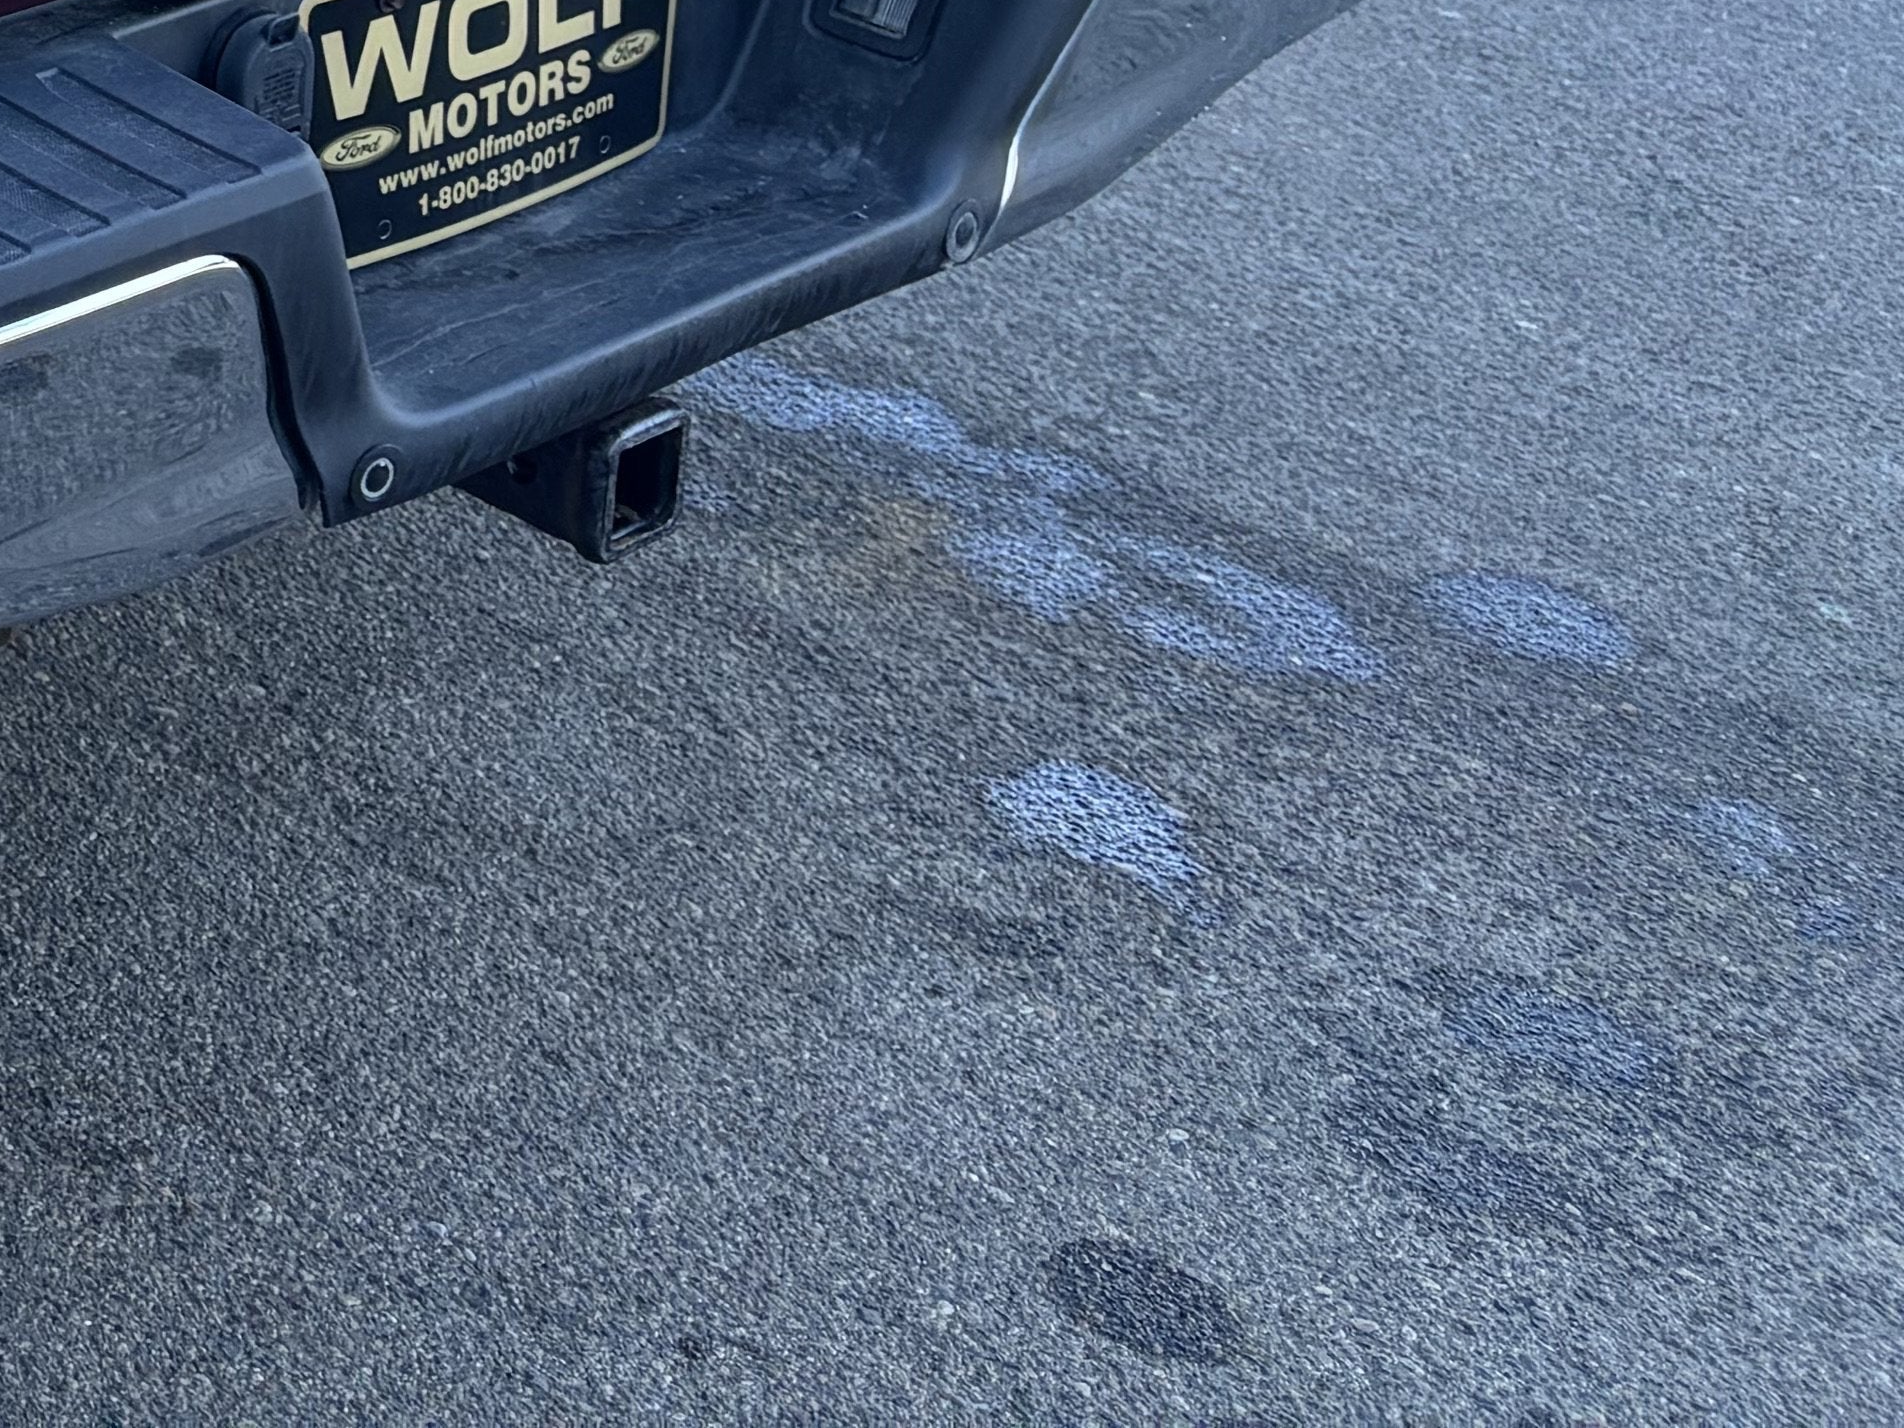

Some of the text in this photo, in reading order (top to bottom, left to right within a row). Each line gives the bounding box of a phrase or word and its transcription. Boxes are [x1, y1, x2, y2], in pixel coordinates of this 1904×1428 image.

[378, 93, 615, 195] www.wolfmotors.com
[408, 49, 592, 154] MOTORS
[335, 133, 382, 162] Ford
[418, 135, 581, 216] 1-800-830-0017
